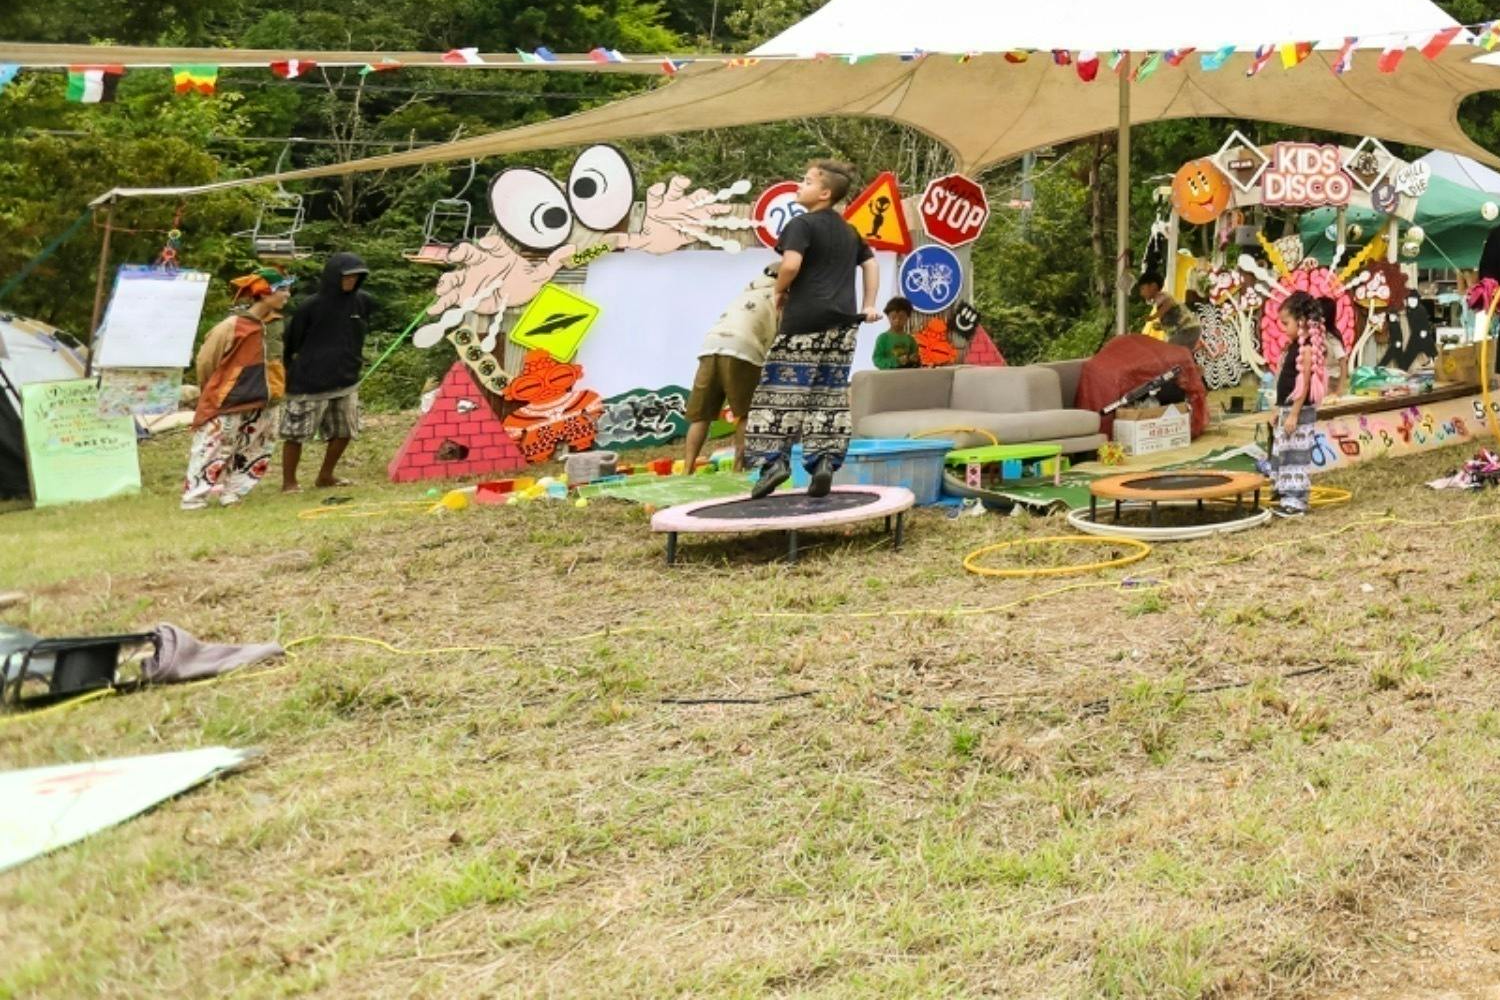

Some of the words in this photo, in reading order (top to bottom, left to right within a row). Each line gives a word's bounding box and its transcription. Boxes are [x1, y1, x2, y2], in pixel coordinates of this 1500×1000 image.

[1277, 146, 1338, 175] KIDS
[1265, 173, 1348, 201] DISCO
[924, 185, 986, 235] STOP
